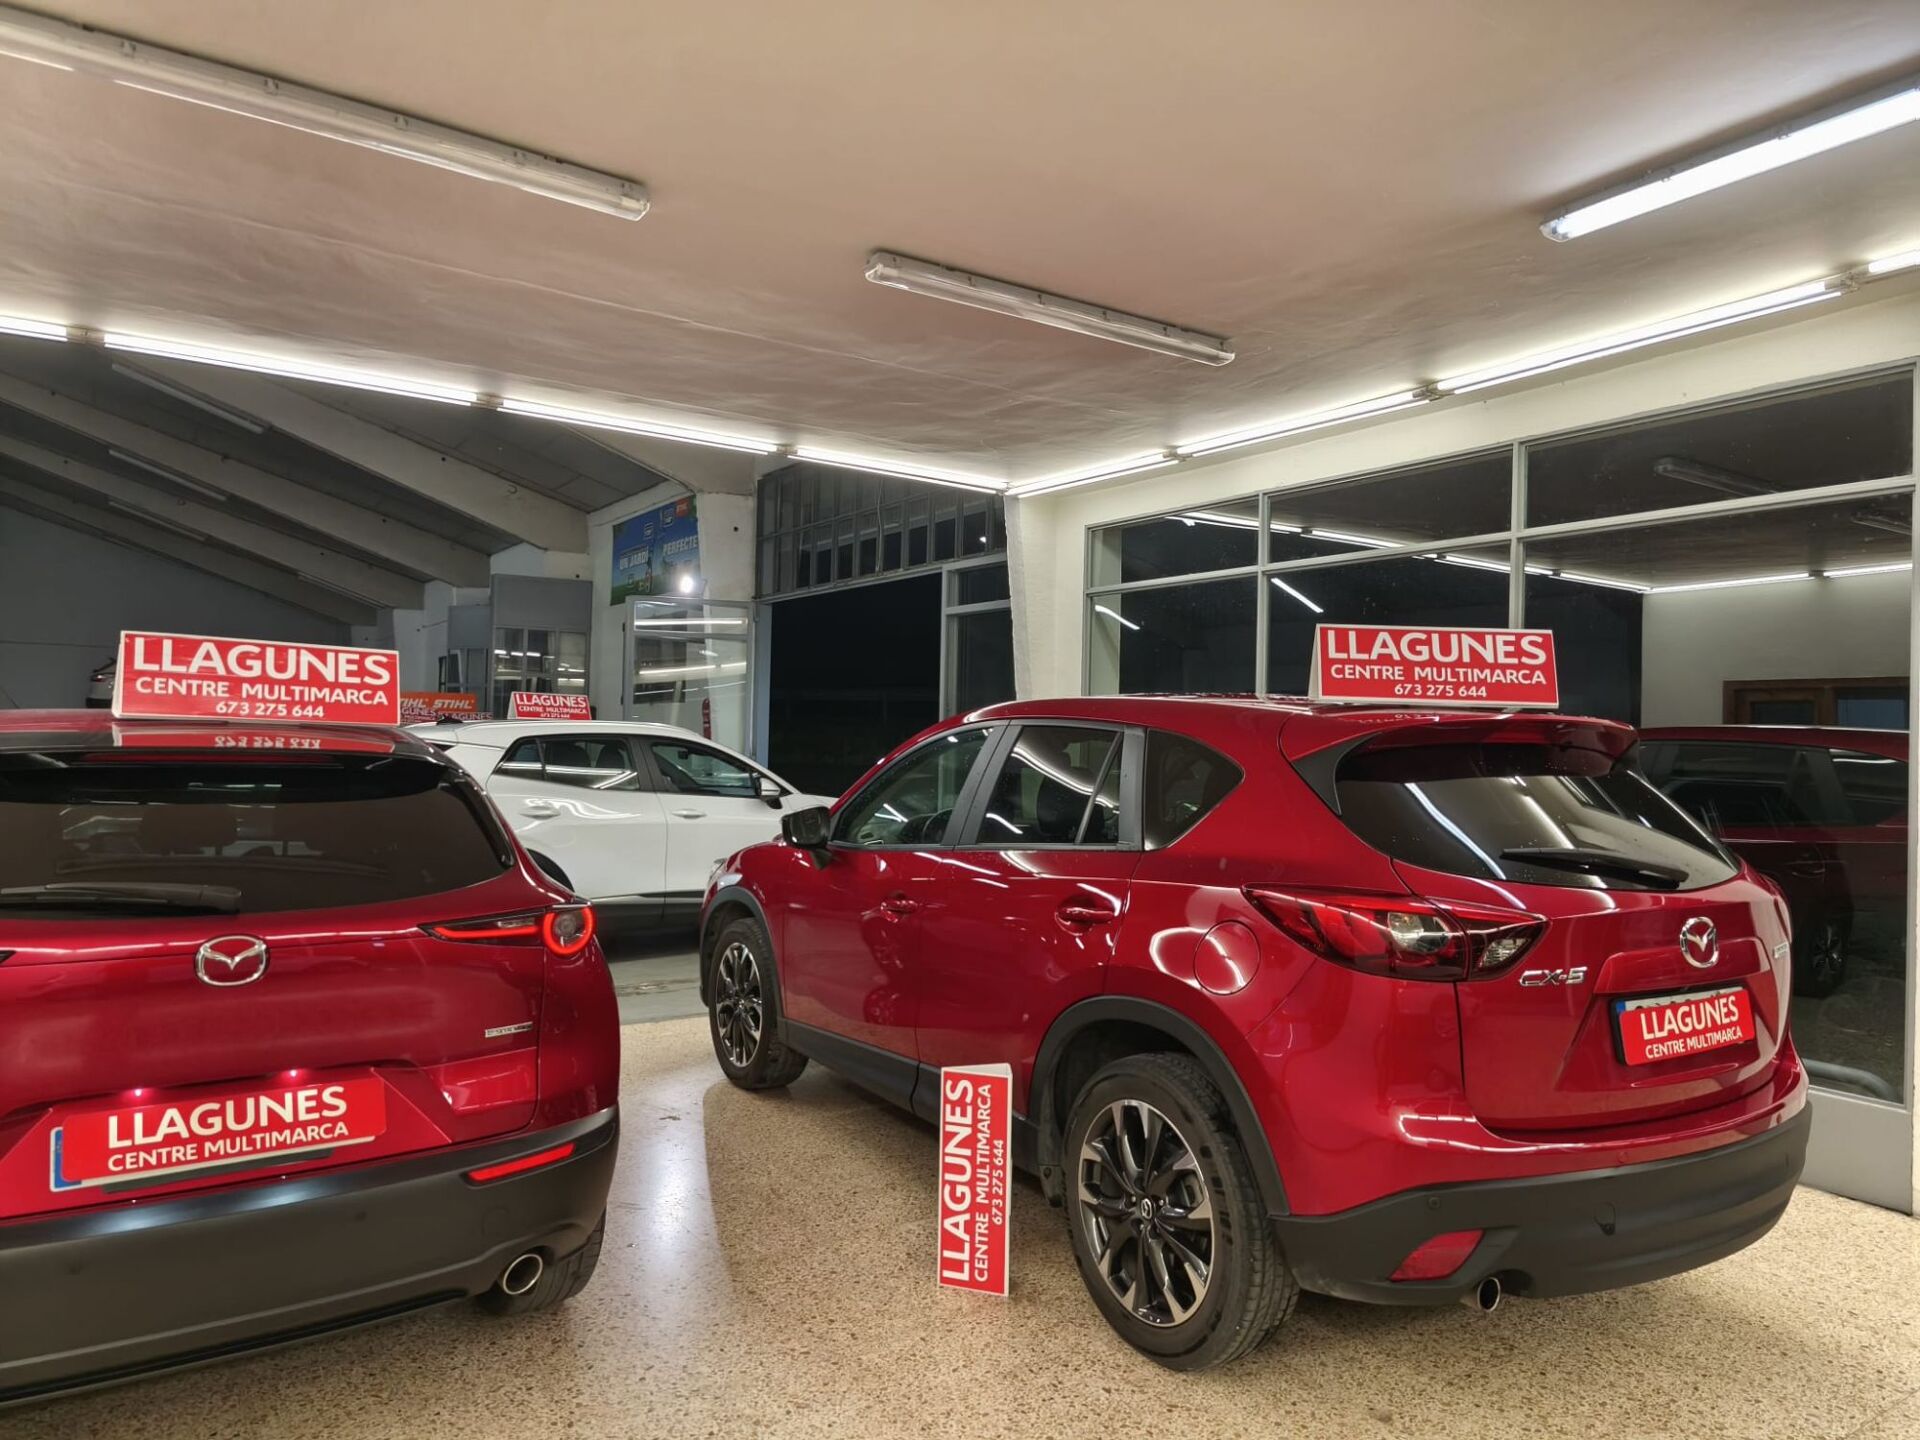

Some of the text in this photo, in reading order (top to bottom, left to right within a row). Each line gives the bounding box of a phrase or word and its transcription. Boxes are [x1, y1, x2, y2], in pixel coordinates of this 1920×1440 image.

[132, 637, 391, 685] LLAGUNES
[1327, 629, 1547, 665] LLAGUNES
[135, 677, 389, 706] CENTRE MULTIMARCA
[1330, 664, 1546, 685] CENTRE MULTIMARCA
[1394, 684, 1487, 697] 673 275 644
[215, 701, 324, 718] 673 275 644
[400, 698, 473, 709] TIHL STIHL
[401, 707, 437, 717] GUNES
[515, 693, 587, 708] LLAGUNES
[1519, 966, 1588, 987] CX-5
[1640, 995, 1739, 1040] LLAGUNES
[1645, 1025, 1743, 1059] CENTRE MULTIMARCA
[108, 1085, 347, 1149] LLAGUNES
[107, 1121, 349, 1172] CENTRE MULTIMARCA
[942, 1079, 974, 1282] LLAGUNES
[974, 1084, 992, 1282] CENTRE MULTIMARCA
[992, 1139, 1004, 1225] 673 275 644
